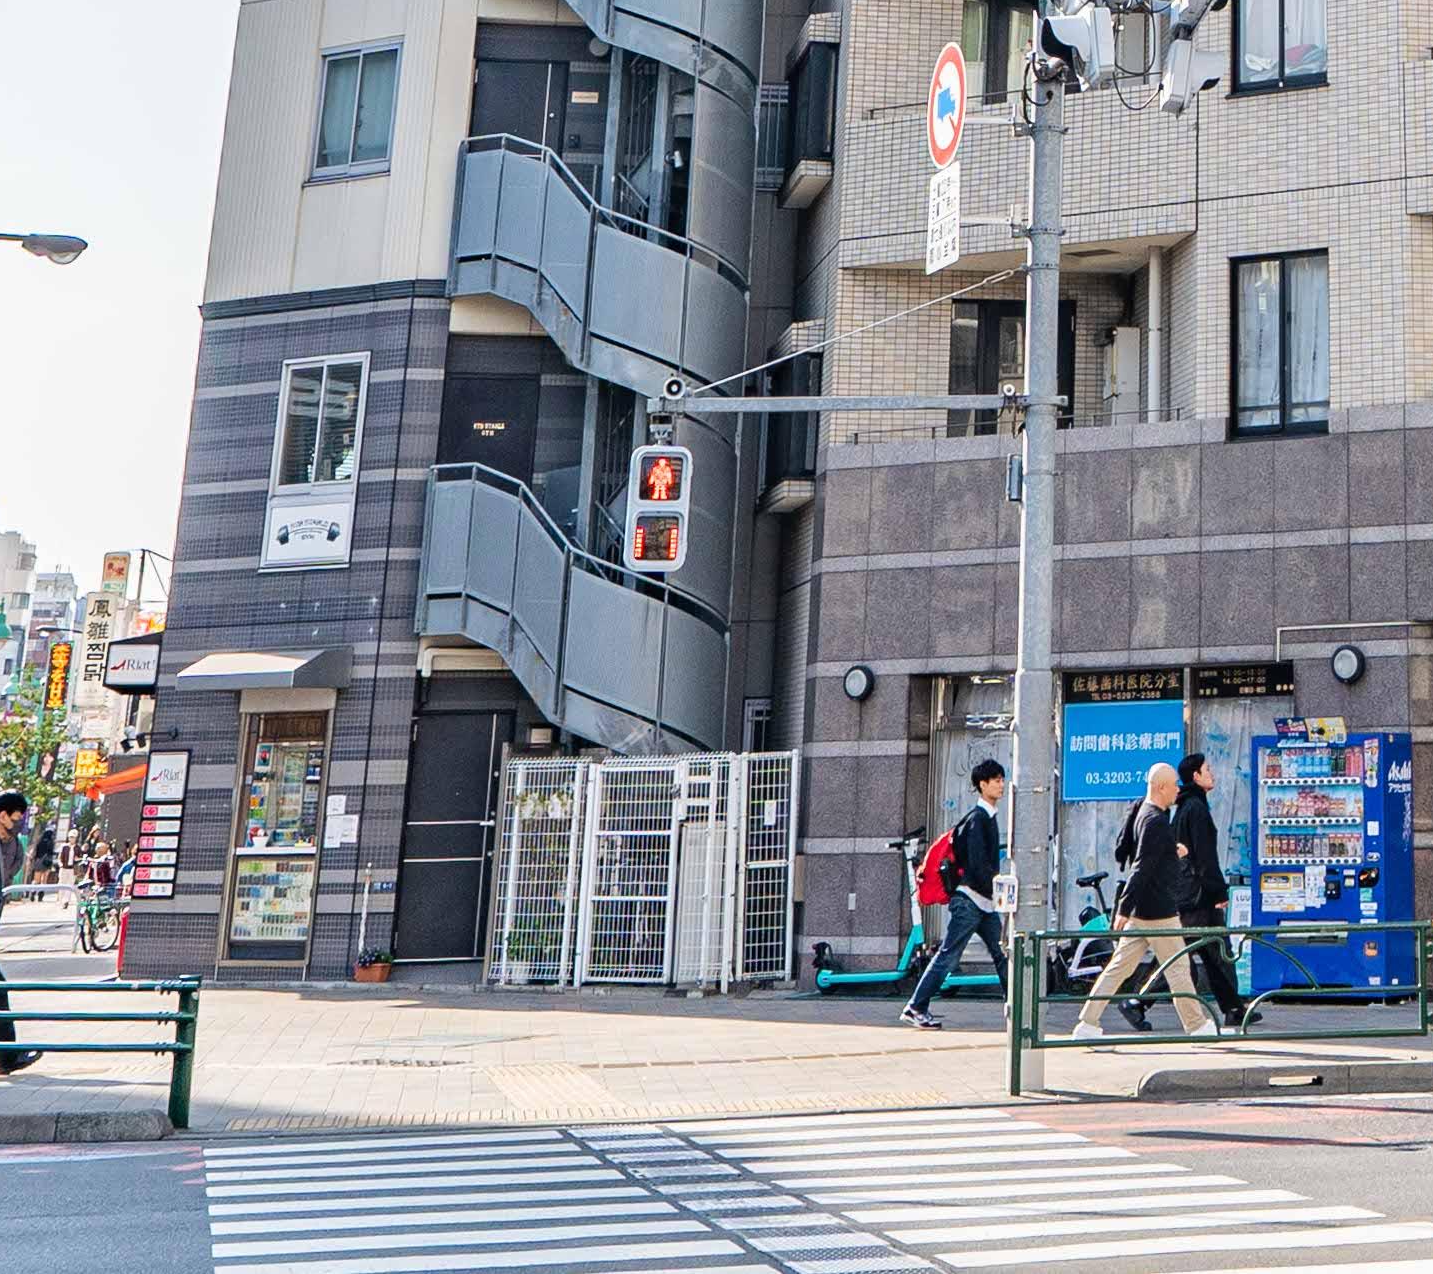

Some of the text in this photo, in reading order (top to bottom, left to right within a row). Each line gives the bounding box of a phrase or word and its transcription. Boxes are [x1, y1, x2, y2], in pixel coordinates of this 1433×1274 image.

[1069, 732, 1182, 752] 訪問歯科診療部門
[1085, 770, 1149, 785] 03-3203-74
